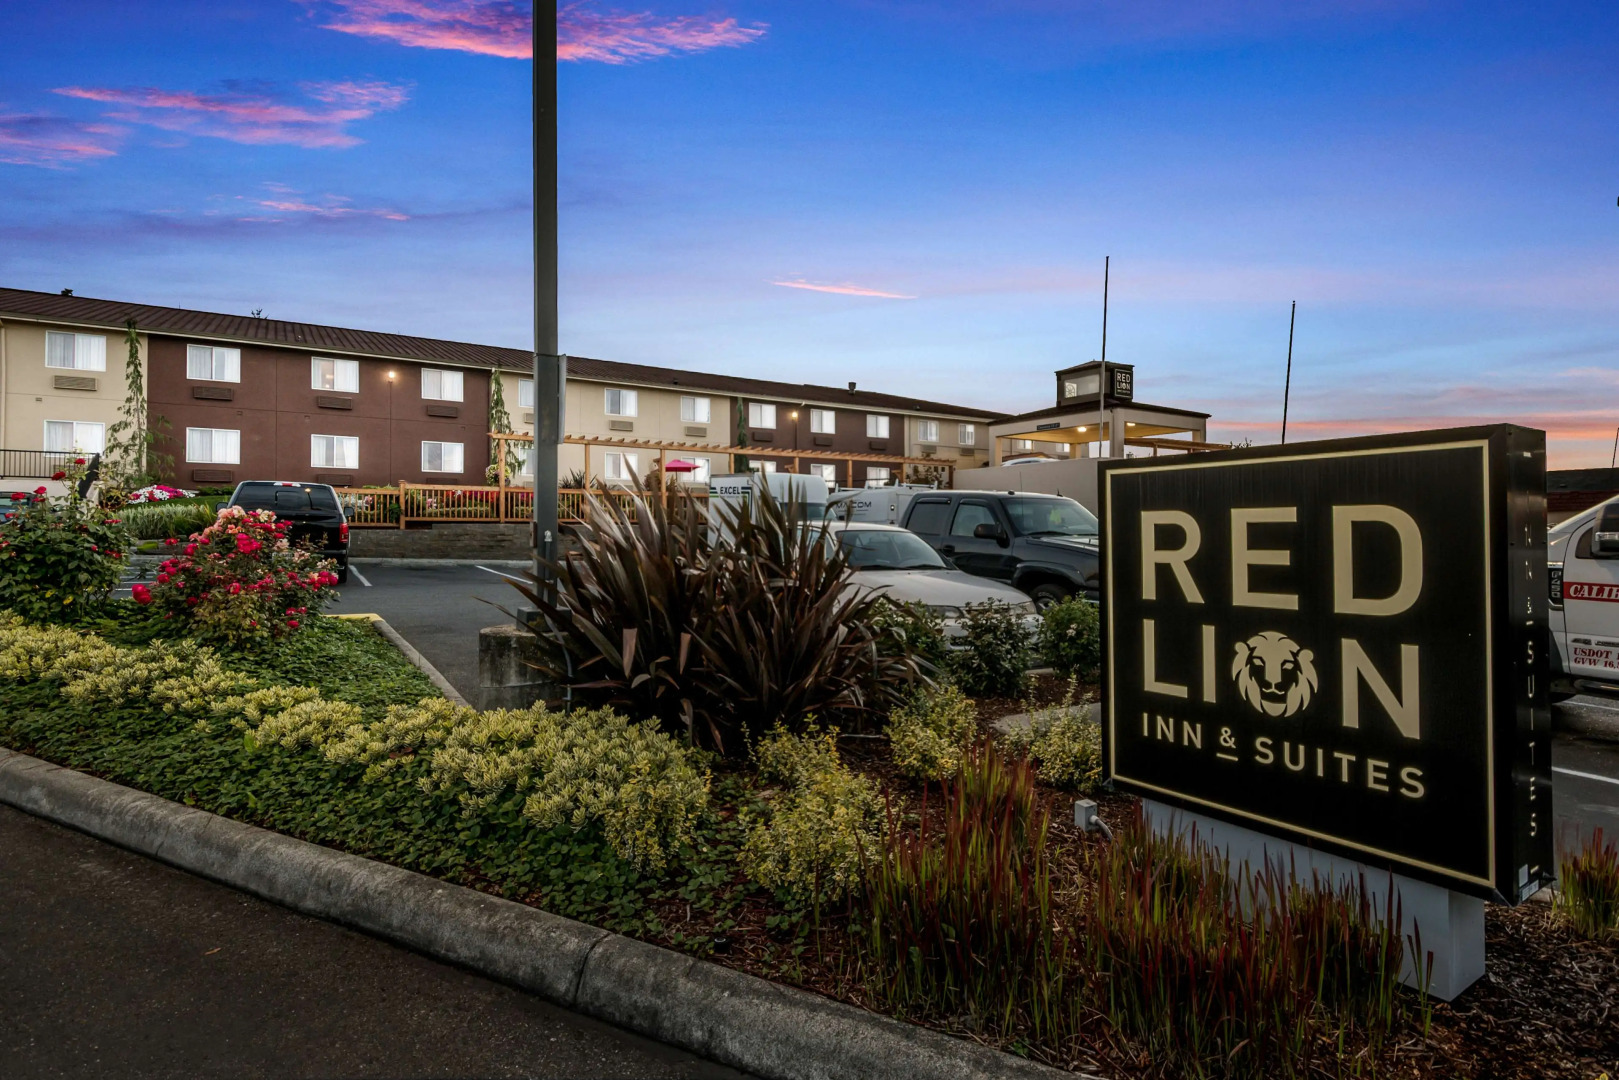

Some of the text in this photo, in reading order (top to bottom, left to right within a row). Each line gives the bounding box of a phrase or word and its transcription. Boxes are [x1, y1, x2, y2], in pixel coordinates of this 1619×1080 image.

[1117, 373, 1131, 382] RED
[720, 486, 741, 495] EXCEL
[1140, 504, 1424, 616] RED
[1574, 647, 1612, 659] USDOT
[1574, 656, 1600, 667] GVW
[1142, 712, 1426, 800] INN & SUITES
